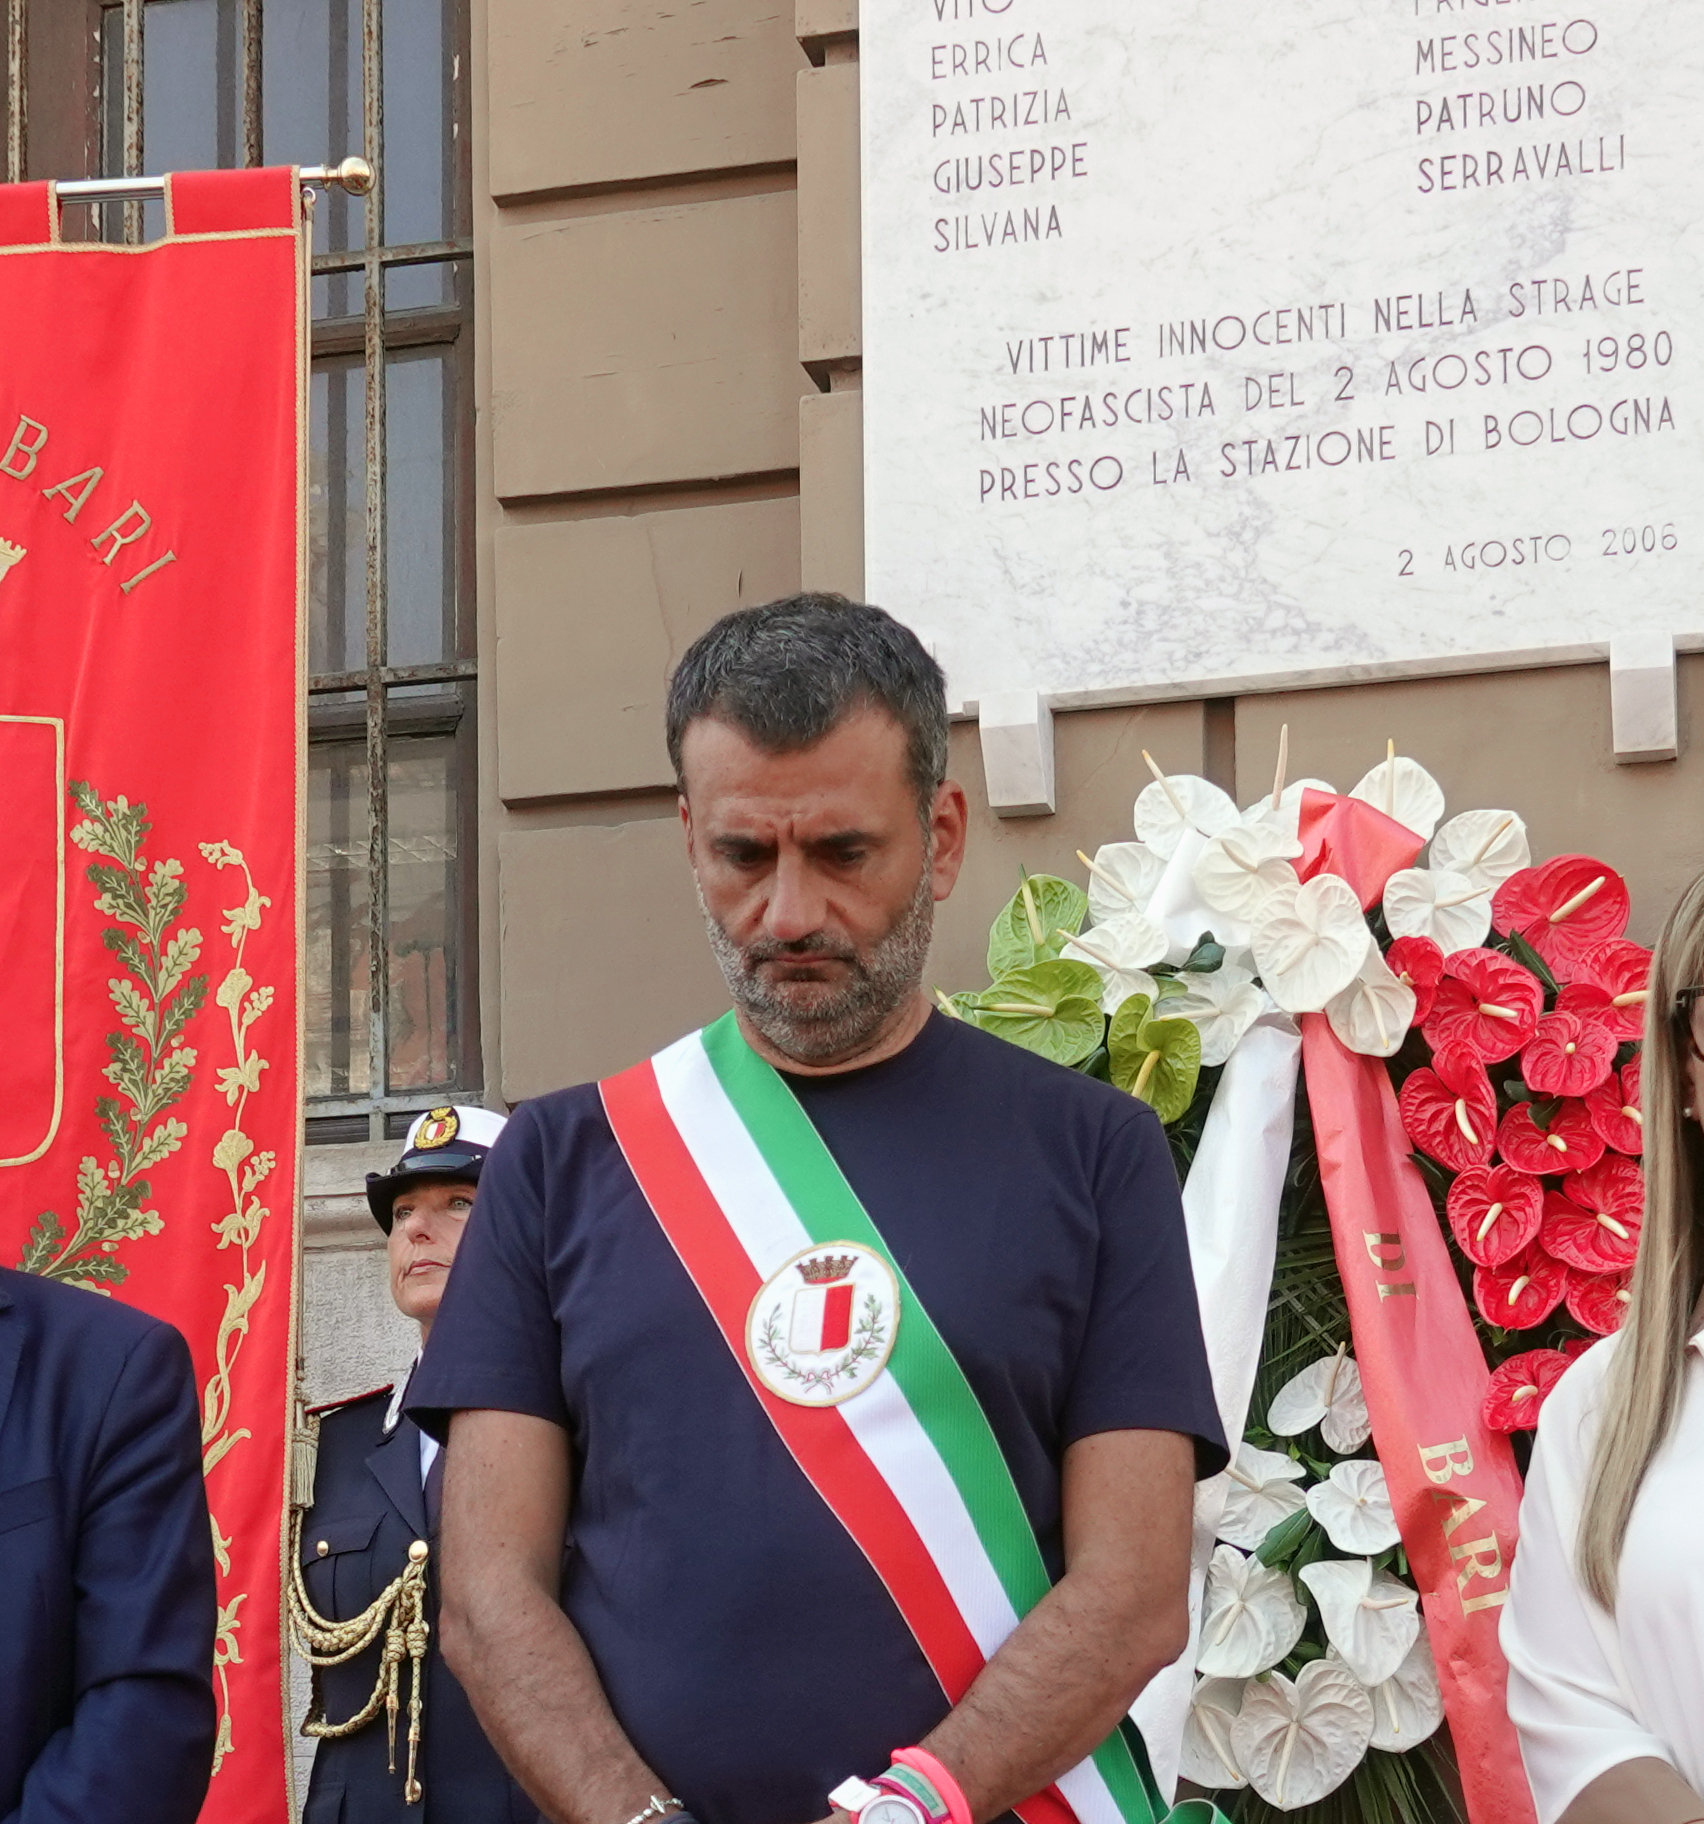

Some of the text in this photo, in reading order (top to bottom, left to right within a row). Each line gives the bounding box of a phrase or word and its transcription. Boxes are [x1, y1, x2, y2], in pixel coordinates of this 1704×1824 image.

[931, 32, 1048, 80] ERRICA
[1416, 19, 1598, 75] MESSINEO
[931, 87, 1072, 138] PATRIZIA
[1415, 79, 1588, 136] PATRUNO
[932, 142, 1090, 195] GIUSEPPE
[1417, 134, 1628, 195] SERRAVALLI
[932, 204, 1064, 254] SILVANA
[1005, 268, 1646, 377] VITTIME INNOCENTI NELLA STRAGE
[980, 331, 1674, 443] NEOFASCISTA DEL 2 AGOSTO 1980
[979, 396, 1676, 504] PRESSO LA STAZIONE DI BOLOGNA
[1398, 522, 1679, 578] 2 AGOSTO 2006
[1362, 1228, 1510, 1621] DI BARI
